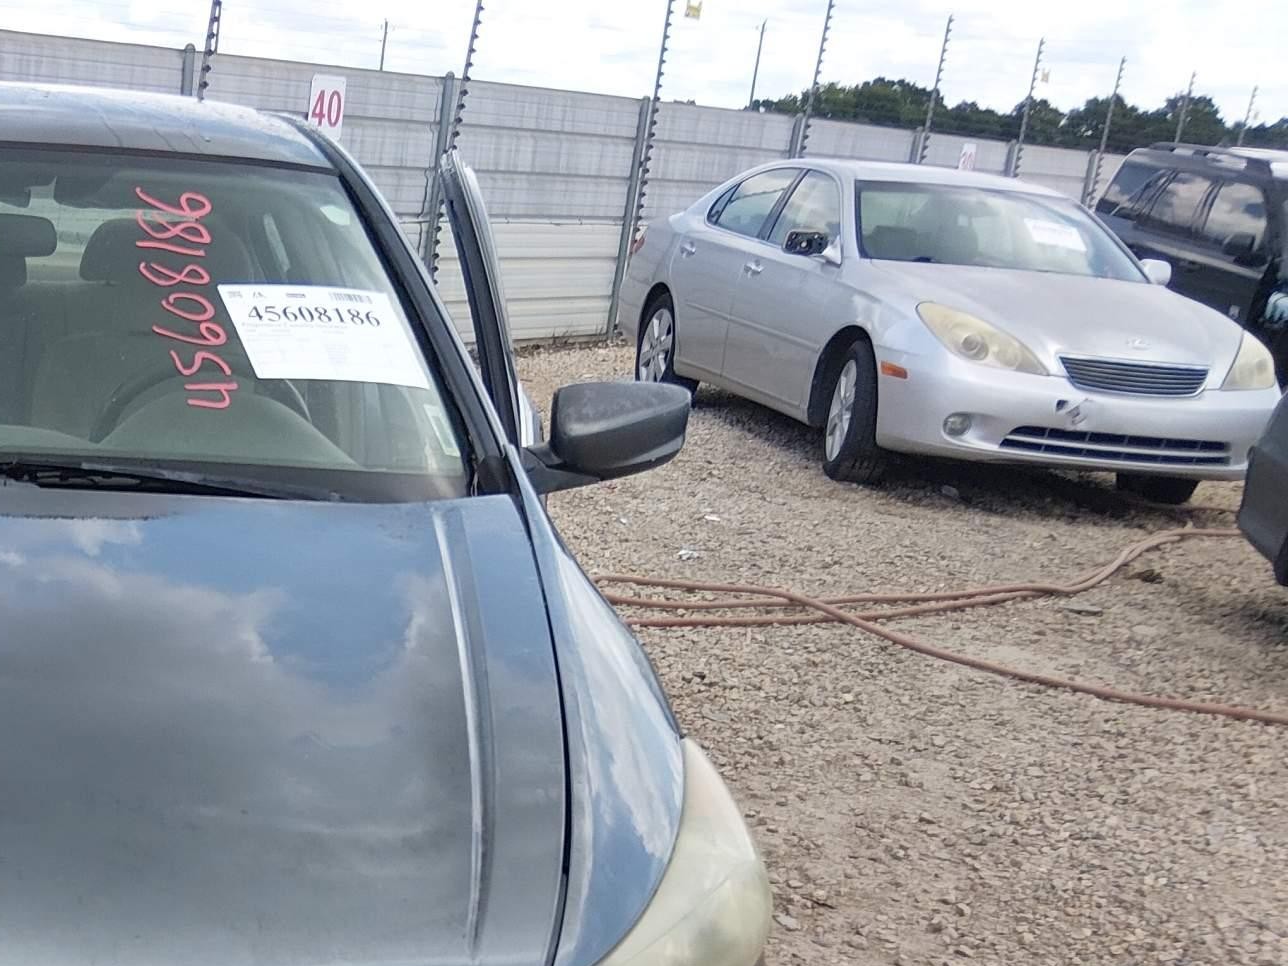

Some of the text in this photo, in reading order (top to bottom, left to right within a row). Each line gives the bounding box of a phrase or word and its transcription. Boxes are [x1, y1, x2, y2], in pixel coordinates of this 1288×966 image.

[311, 89, 342, 127] 40
[135, 186, 239, 410] 45608186
[248, 305, 381, 328] 45608186
